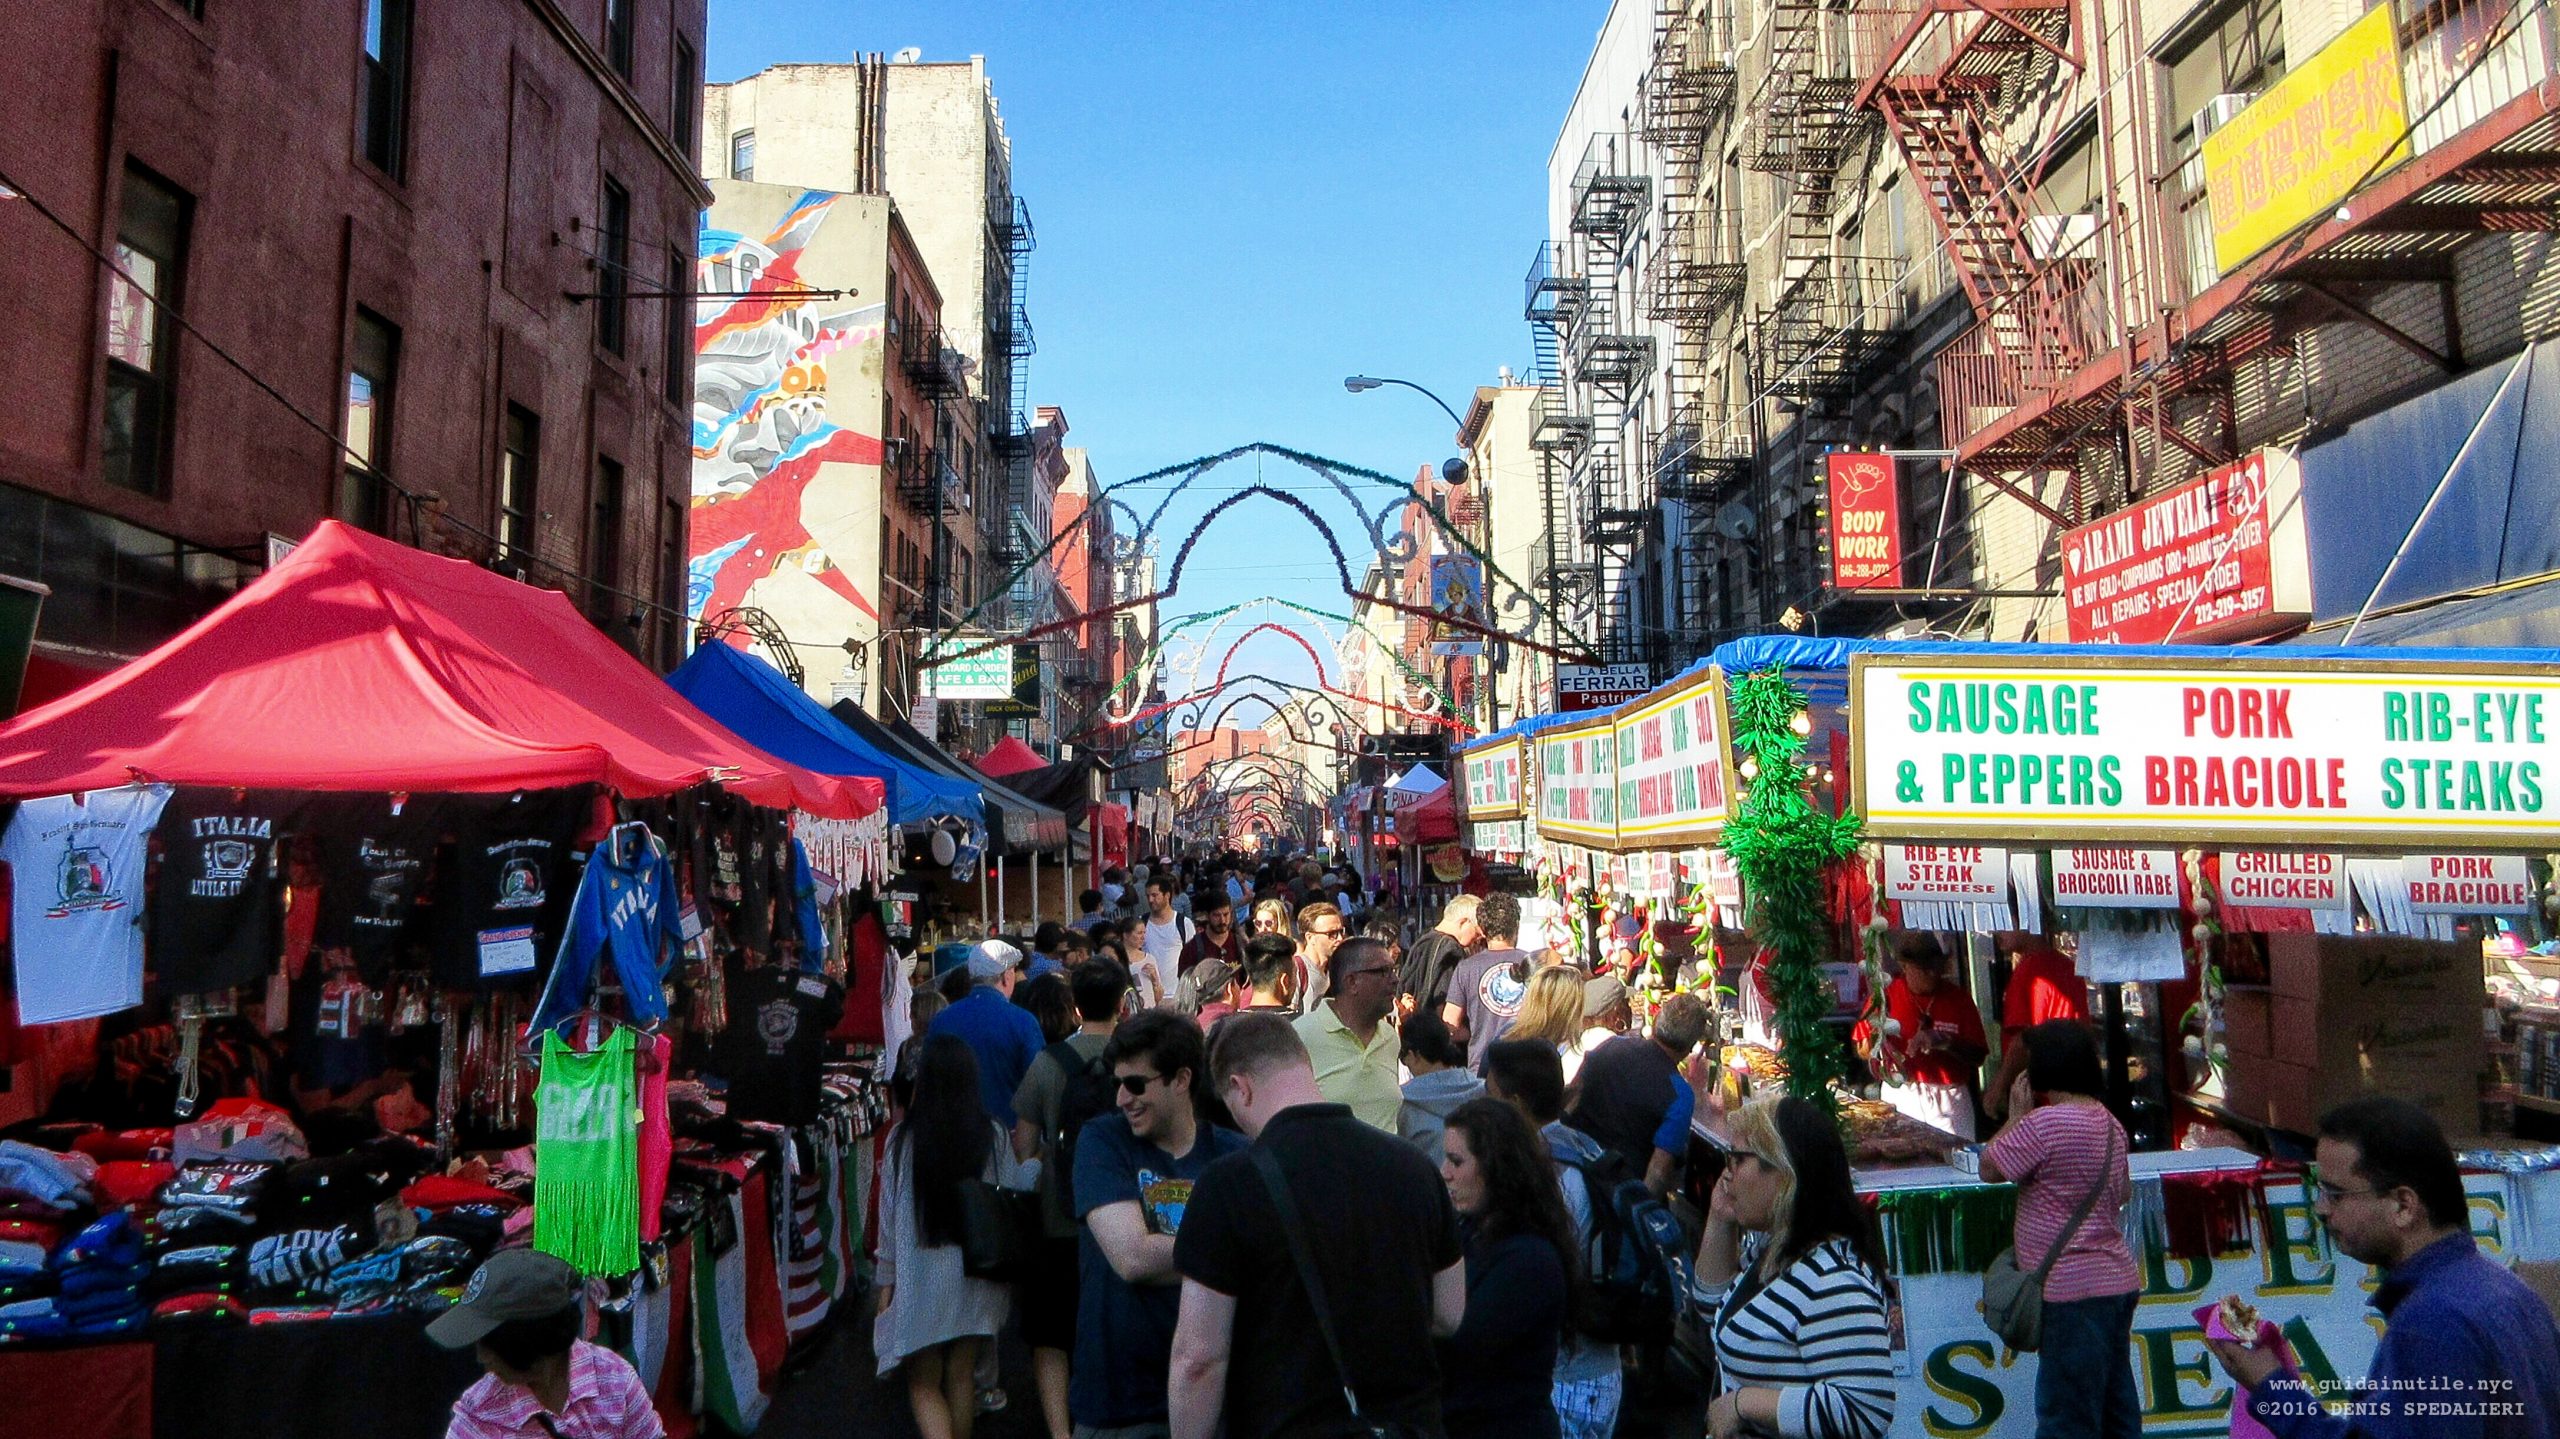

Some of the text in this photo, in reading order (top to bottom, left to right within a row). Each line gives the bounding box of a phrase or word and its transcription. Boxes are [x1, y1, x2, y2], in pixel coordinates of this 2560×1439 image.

[1842, 511, 1885, 533] BODY
[2083, 479, 2221, 573] ARAMI JEWELRY
[1839, 537, 1889, 559] WORK
[2071, 586, 2084, 608] WE
[2084, 581, 2097, 604] BUY
[2091, 561, 2241, 630] ALL REPAIRS SPECIAL ORDER
[2194, 586, 2265, 625] 212-219-3157
[965, 674, 975, 684] &
[979, 674, 1006, 684] BAR
[1578, 666, 1642, 675] LA BELLA
[1907, 681, 2099, 736] SAUSAGE
[2182, 687, 2293, 739] PORK
[2384, 692, 2545, 744] RIB-EYE
[1895, 753, 2121, 805] & PEPPERS
[2145, 756, 2347, 809] BRACIOLE
[2381, 758, 2543, 812] STEAKS
[191, 816, 272, 839] ITALIA
[1904, 845, 1983, 864] RIB-EYE
[2071, 849, 2151, 871] SAUSAGE &
[2235, 852, 2332, 875] GRILLED
[1909, 864, 1974, 882] STEAK
[2430, 856, 2494, 879] PORK
[191, 879, 227, 897] LITTLE
[1896, 883, 1996, 894] W CHEESE
[2058, 873, 2173, 896] BROCCOLI RABE
[2230, 876, 2334, 899] CHICKEN
[2409, 882, 2526, 905] BRACIOLE
